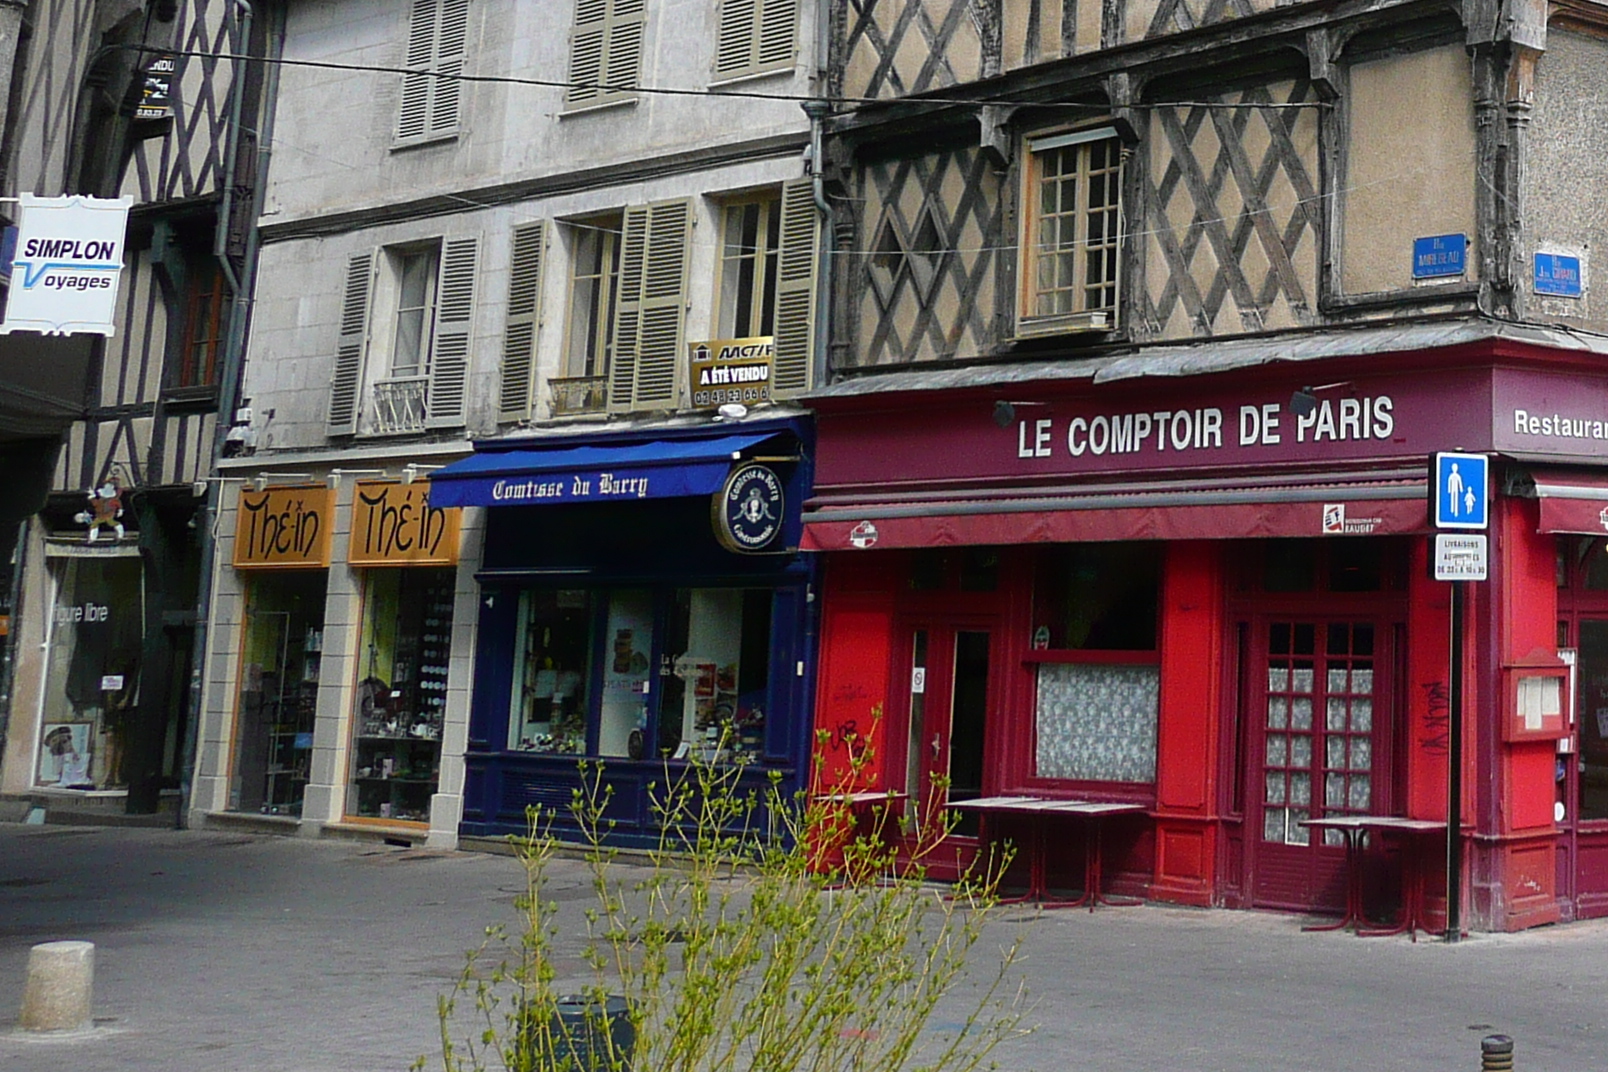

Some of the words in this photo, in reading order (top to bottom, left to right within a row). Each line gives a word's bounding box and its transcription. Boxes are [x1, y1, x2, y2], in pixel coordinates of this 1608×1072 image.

[24, 239, 115, 260] SIMPLON
[22, 262, 111, 291] Voyages
[700, 370, 710, 385] A
[711, 365, 730, 384] ÉTÉ
[730, 365, 768, 383] VENDU
[743, 387, 758, 401] 66
[761, 385, 770, 400] 6
[1018, 419, 1052, 458] LE
[1067, 407, 1223, 457] COMPTOIR
[1239, 403, 1281, 446] DE
[1297, 395, 1394, 443] PARIS
[571, 475, 591, 496] du
[599, 473, 649, 497] Barry
